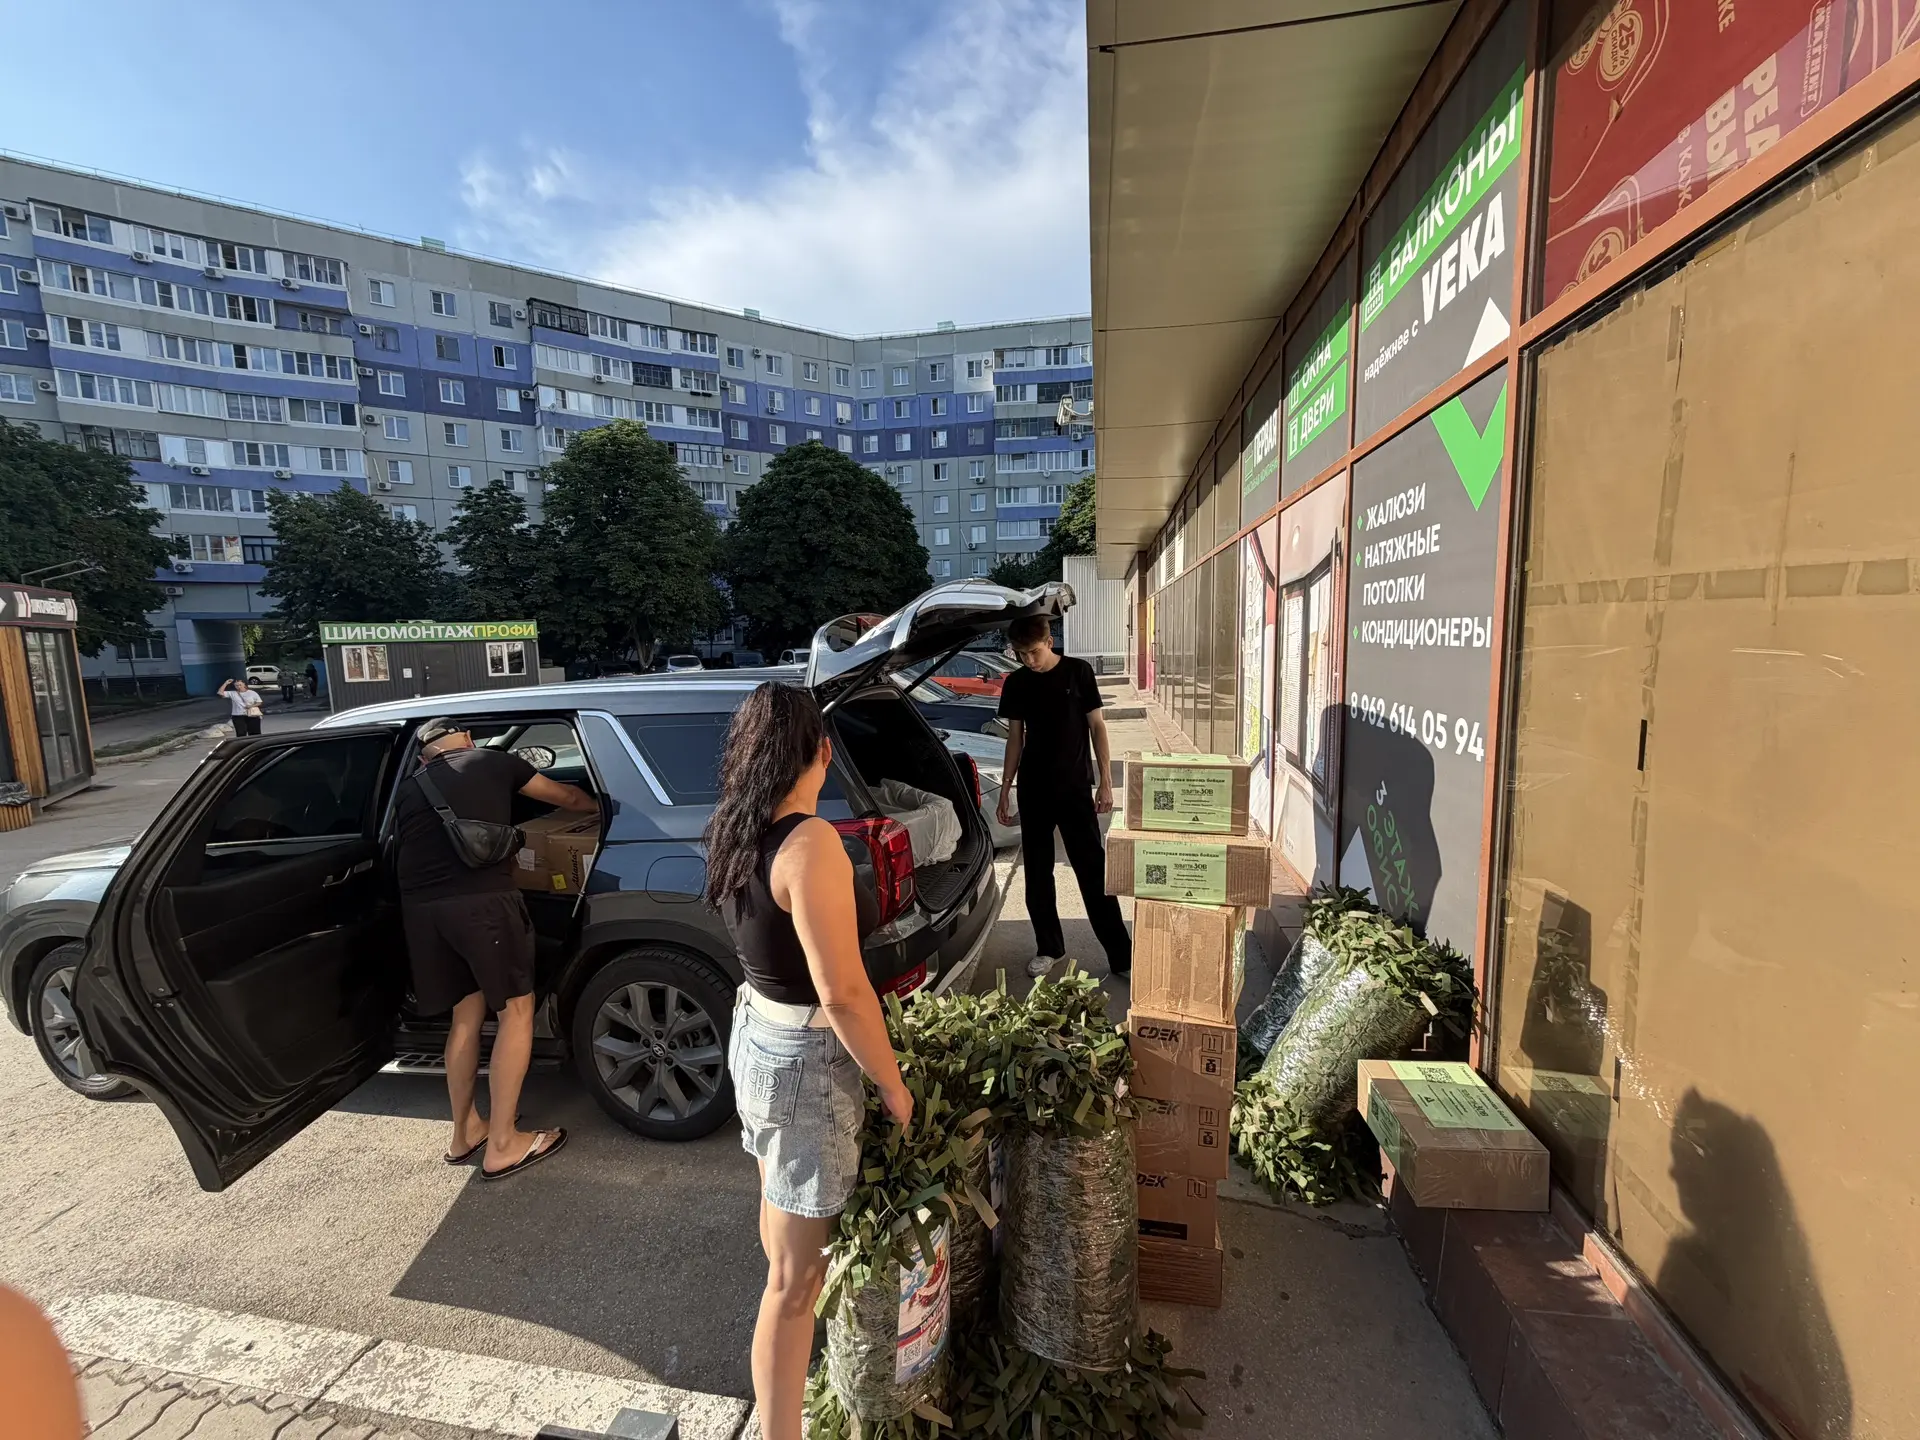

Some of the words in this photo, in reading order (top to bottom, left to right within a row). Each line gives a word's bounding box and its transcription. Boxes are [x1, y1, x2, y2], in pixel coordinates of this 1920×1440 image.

[1618, 17, 1635, 67] 25%
[1717, 0, 1736, 33] КЕ
[1611, 30, 1619, 72] СКИДКА
[1389, 88, 1517, 287] БАЛКОНЫ
[1677, 145, 1692, 212] КАЖ
[1364, 329, 1409, 383] надёжнее
[1411, 319, 1419, 338] с
[1422, 192, 1505, 325] VEKA
[1302, 334, 1332, 389] ОКНА
[1253, 407, 1278, 467] ПЕРВАЯ
[1300, 382, 1335, 446] ДВЕРИ
[1366, 482, 1426, 531] ЖАЛЮЗИ
[1364, 523, 1441, 568] НАТЯЖНЫЕ
[1363, 573, 1426, 606] ПОТОЛКИ
[1361, 616, 1492, 650] КОНДИЦИОНЕРЫ
[1350, 691, 1358, 719] 8
[1361, 694, 1385, 729] 962
[1389, 702, 1417, 739] 614
[1422, 709, 1447, 749] 05
[1454, 717, 1485, 762] 94
[1367, 804, 1398, 913] ОФИС
[1376, 780, 1388, 806] 3
[1384, 810, 1420, 920] ЭТАЖ
[1137, 1026, 1182, 1042] CDEK
[1137, 1173, 1168, 1188] DEK
